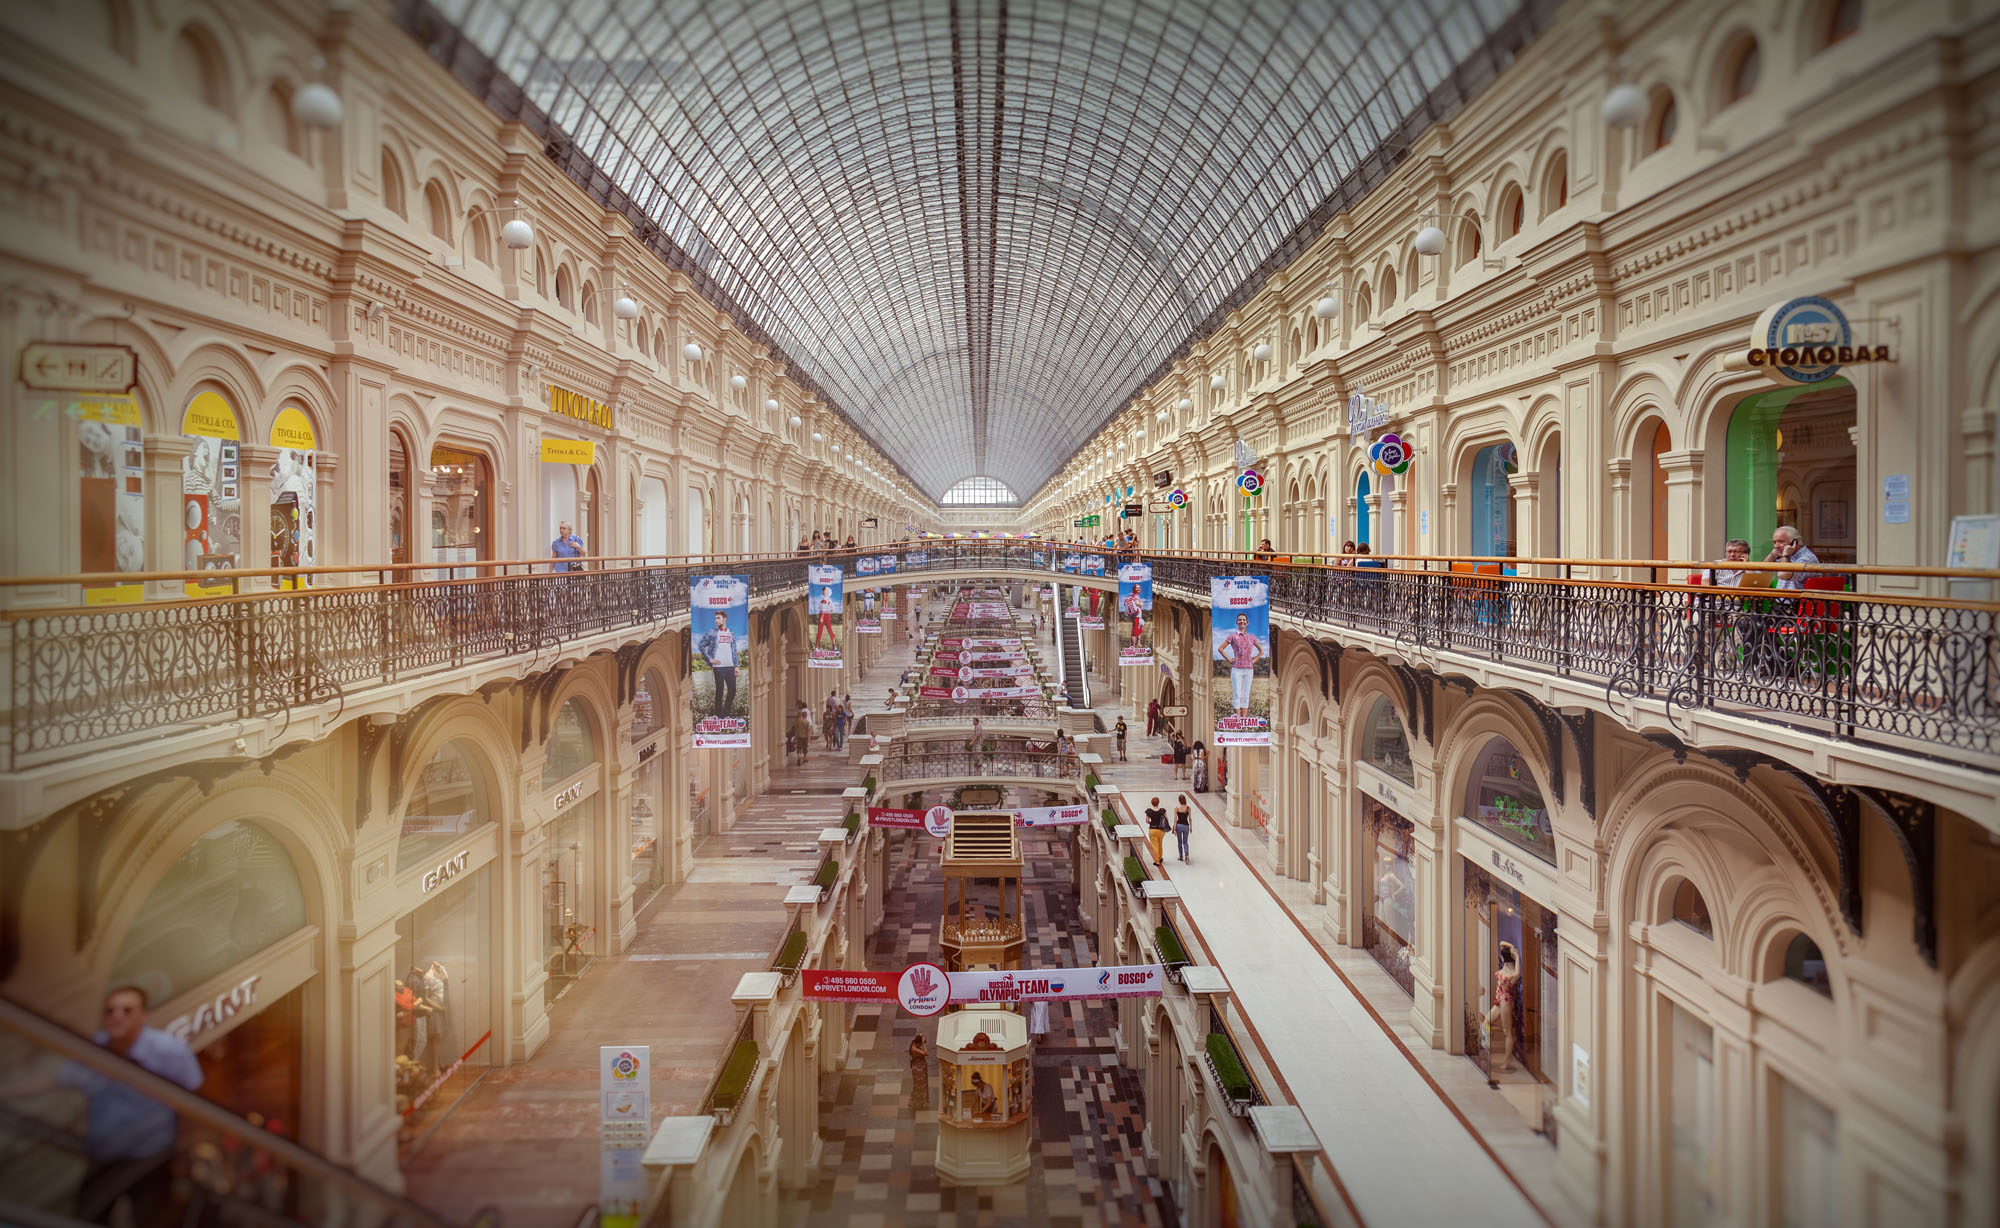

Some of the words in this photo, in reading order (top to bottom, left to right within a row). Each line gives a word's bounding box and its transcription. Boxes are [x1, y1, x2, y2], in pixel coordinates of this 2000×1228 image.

[1747, 345, 1889, 366] СТОЛОВАЯ
[548, 384, 589, 422] TIVOLI
[709, 597, 728, 605] BOSCO
[1229, 597, 1248, 605] BOSCO
[719, 720, 738, 728] TEAM
[1240, 718, 1258, 727] TEAM
[553, 781, 585, 812] GANT
[1061, 810, 1079, 818] BOSCO
[422, 850, 470, 894] GANT
[830, 976, 844, 984] 495
[845, 977, 858, 985] 660
[859, 978, 877, 986] 0550
[1118, 972, 1146, 985] BOSCO
[821, 984, 887, 993] PRIVETLONDON.COM
[988, 980, 1014, 989] RUSSIAN
[1018, 979, 1049, 995] TEAM
[979, 988, 1021, 1001] OLYMPIC
